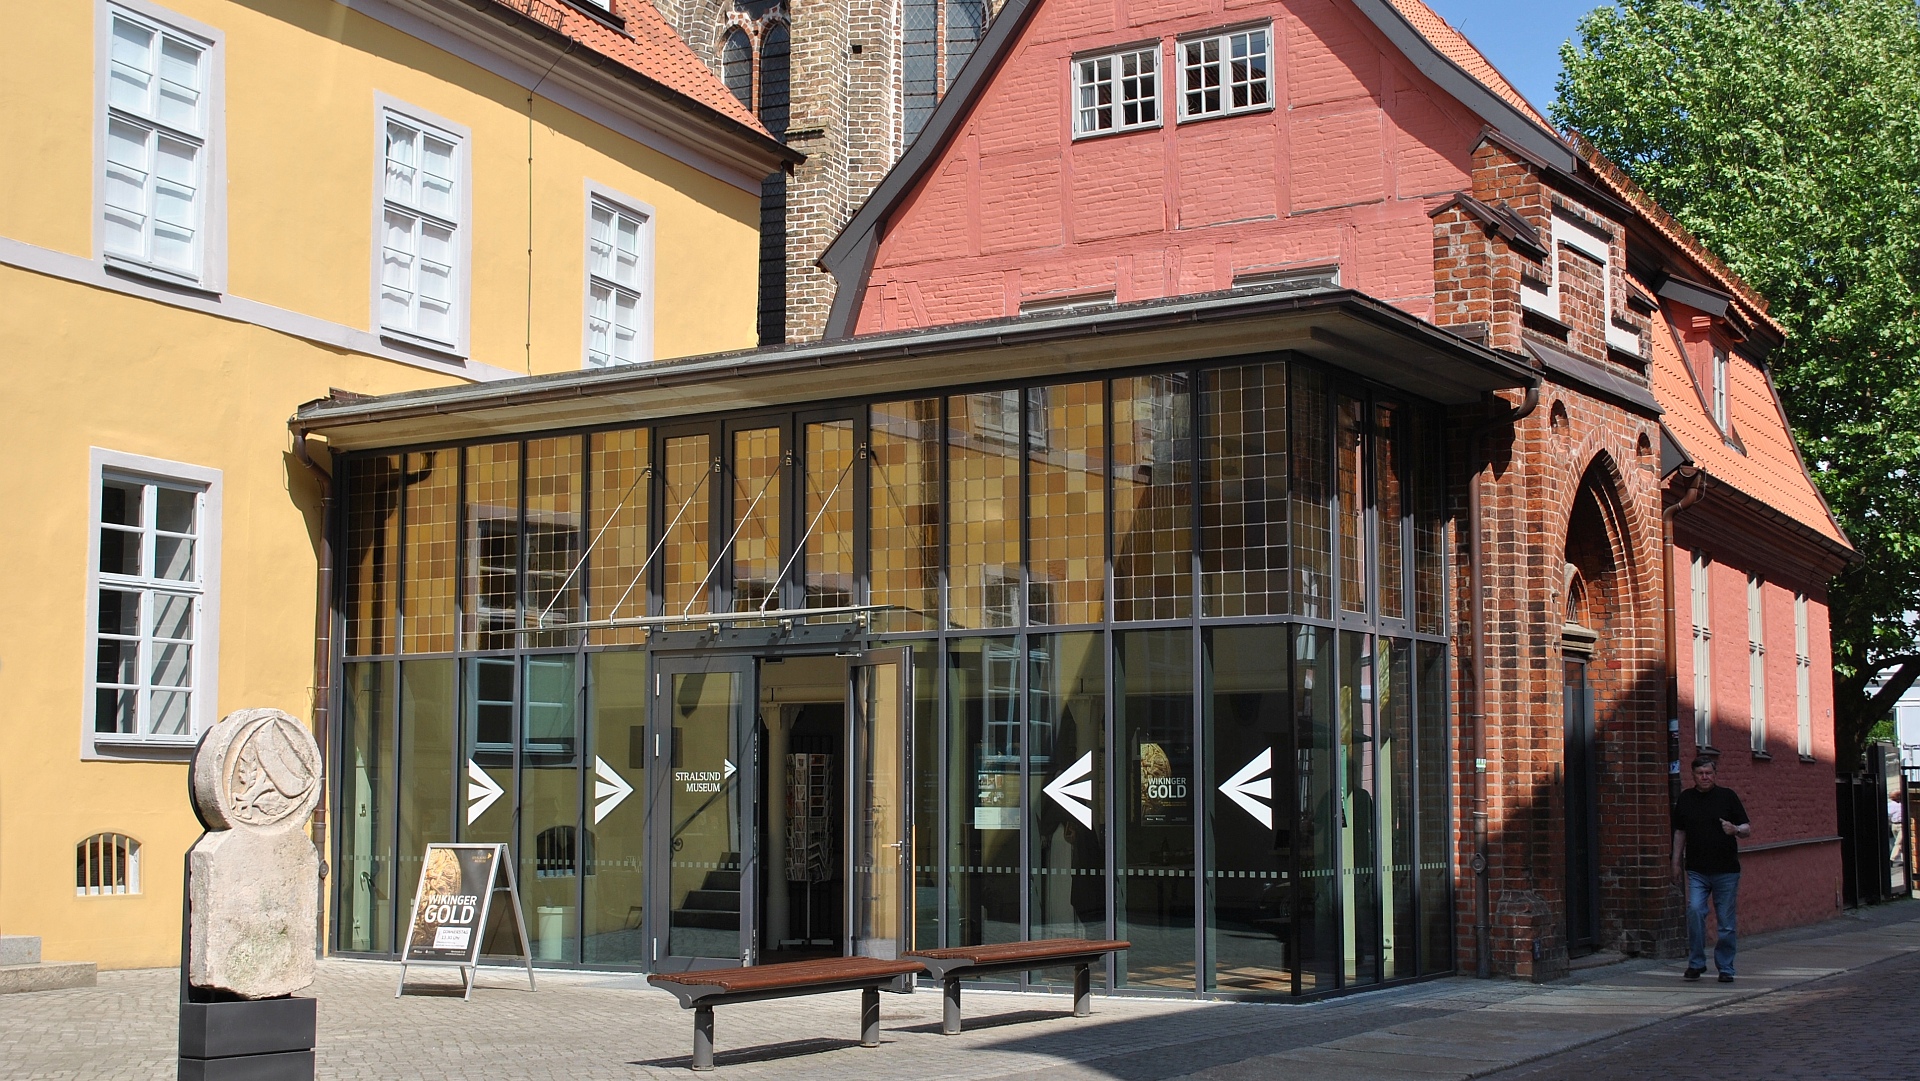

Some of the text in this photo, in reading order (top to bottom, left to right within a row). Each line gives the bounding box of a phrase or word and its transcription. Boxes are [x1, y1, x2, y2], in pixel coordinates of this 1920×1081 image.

[676, 772, 721, 781] STRALSUND
[686, 783, 720, 792] MUSEUM
[1148, 785, 1186, 799] GOLD
[428, 895, 477, 905] WIKINGER
[424, 904, 474, 923] GOLD
